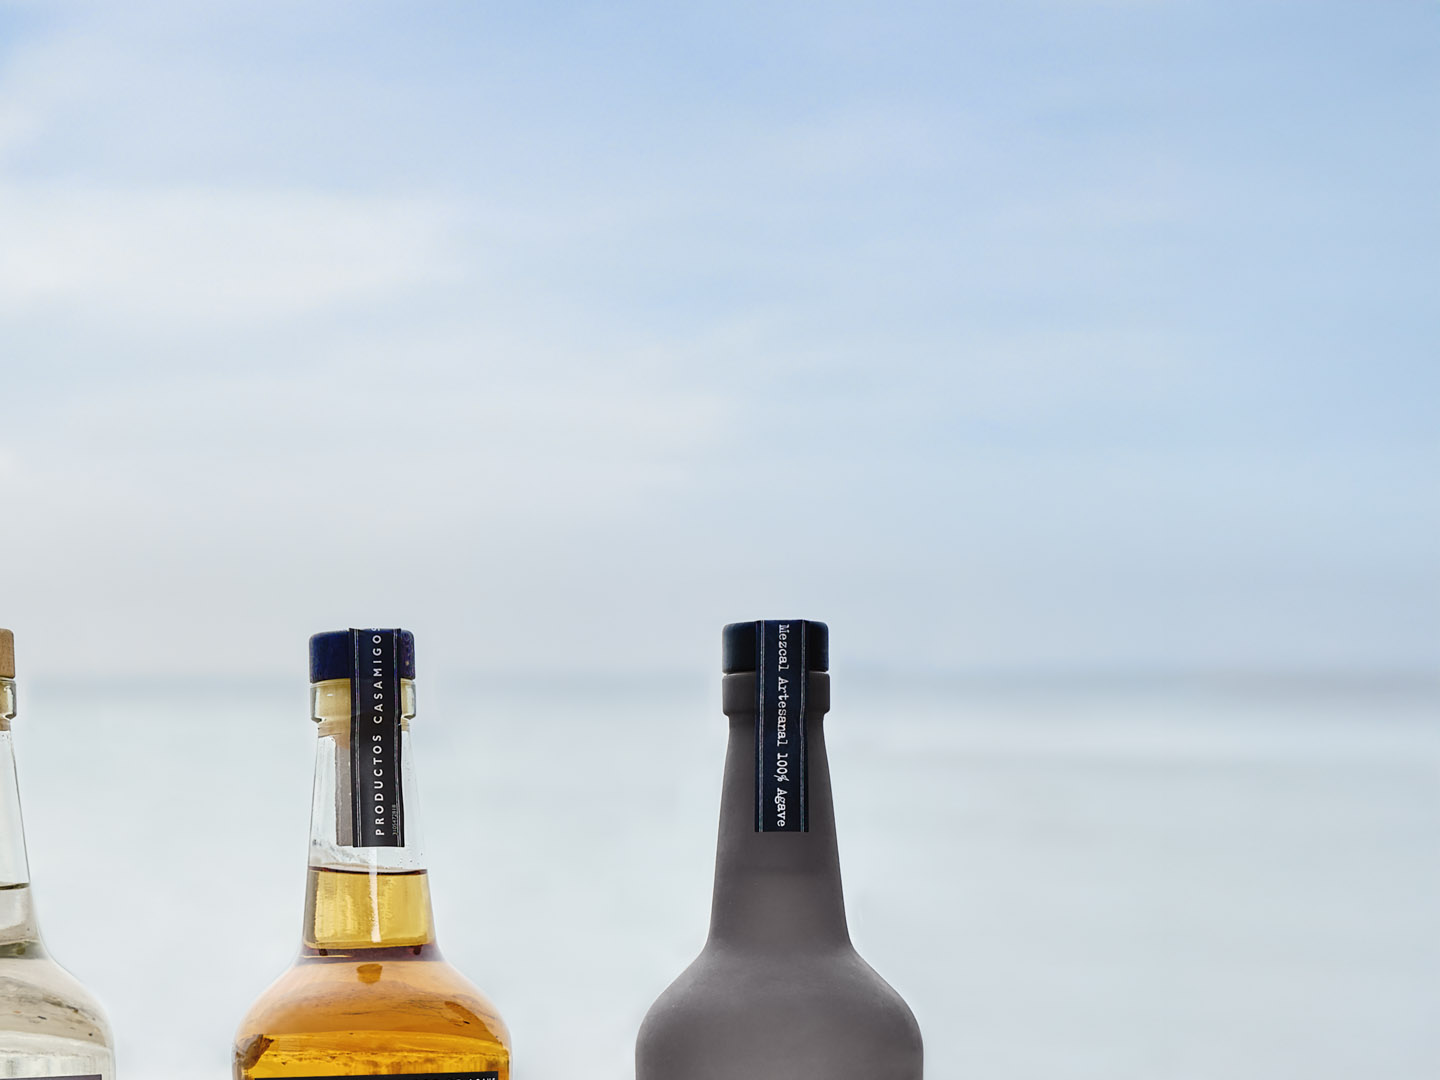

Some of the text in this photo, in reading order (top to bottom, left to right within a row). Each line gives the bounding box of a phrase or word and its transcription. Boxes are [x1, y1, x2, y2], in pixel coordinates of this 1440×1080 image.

[372, 735, 384, 836] PRODUCTOS
[773, 624, 790, 827] Mezcal Artesanal 100% Agave
